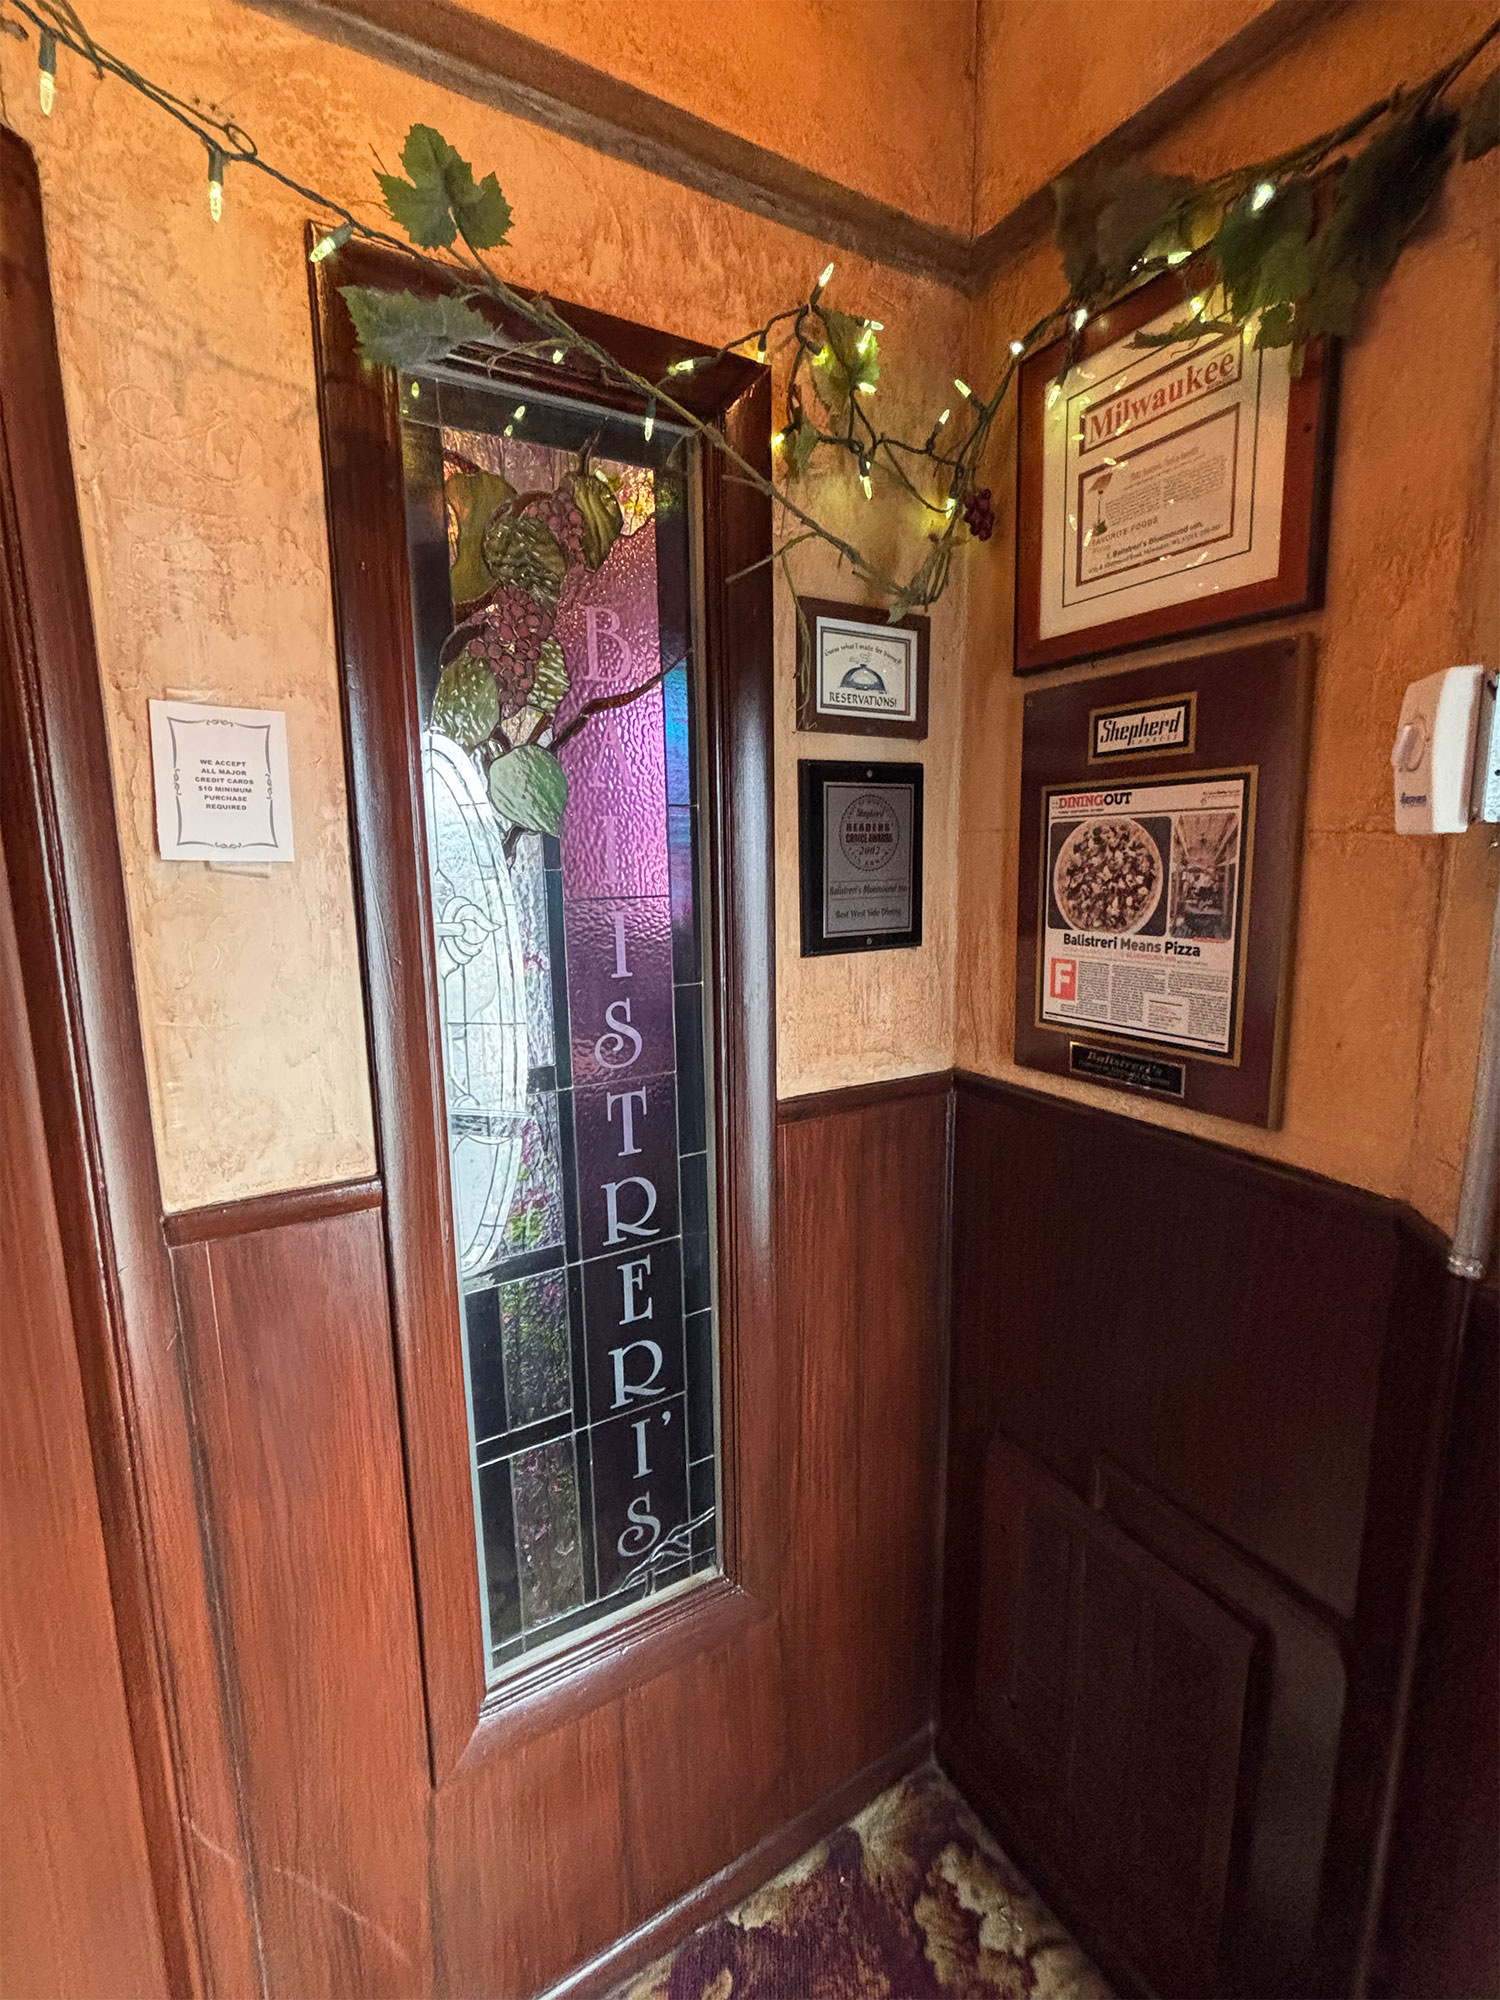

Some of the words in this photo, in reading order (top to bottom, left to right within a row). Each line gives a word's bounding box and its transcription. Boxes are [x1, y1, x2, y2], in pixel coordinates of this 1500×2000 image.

[1089, 353, 1234, 444] Milwaukee
[829, 691, 897, 708] RESERVATIONS!
[1100, 710, 1182, 746] Shepherd
[195, 776, 224, 784] CREDIT
[204, 794, 247, 802] PURCHASE
[205, 803, 247, 811] REQUIRED
[1063, 933, 1118, 950] Balistreri
[1120, 938, 1161, 953] Means
[1164, 941, 1201, 957] Pizza
